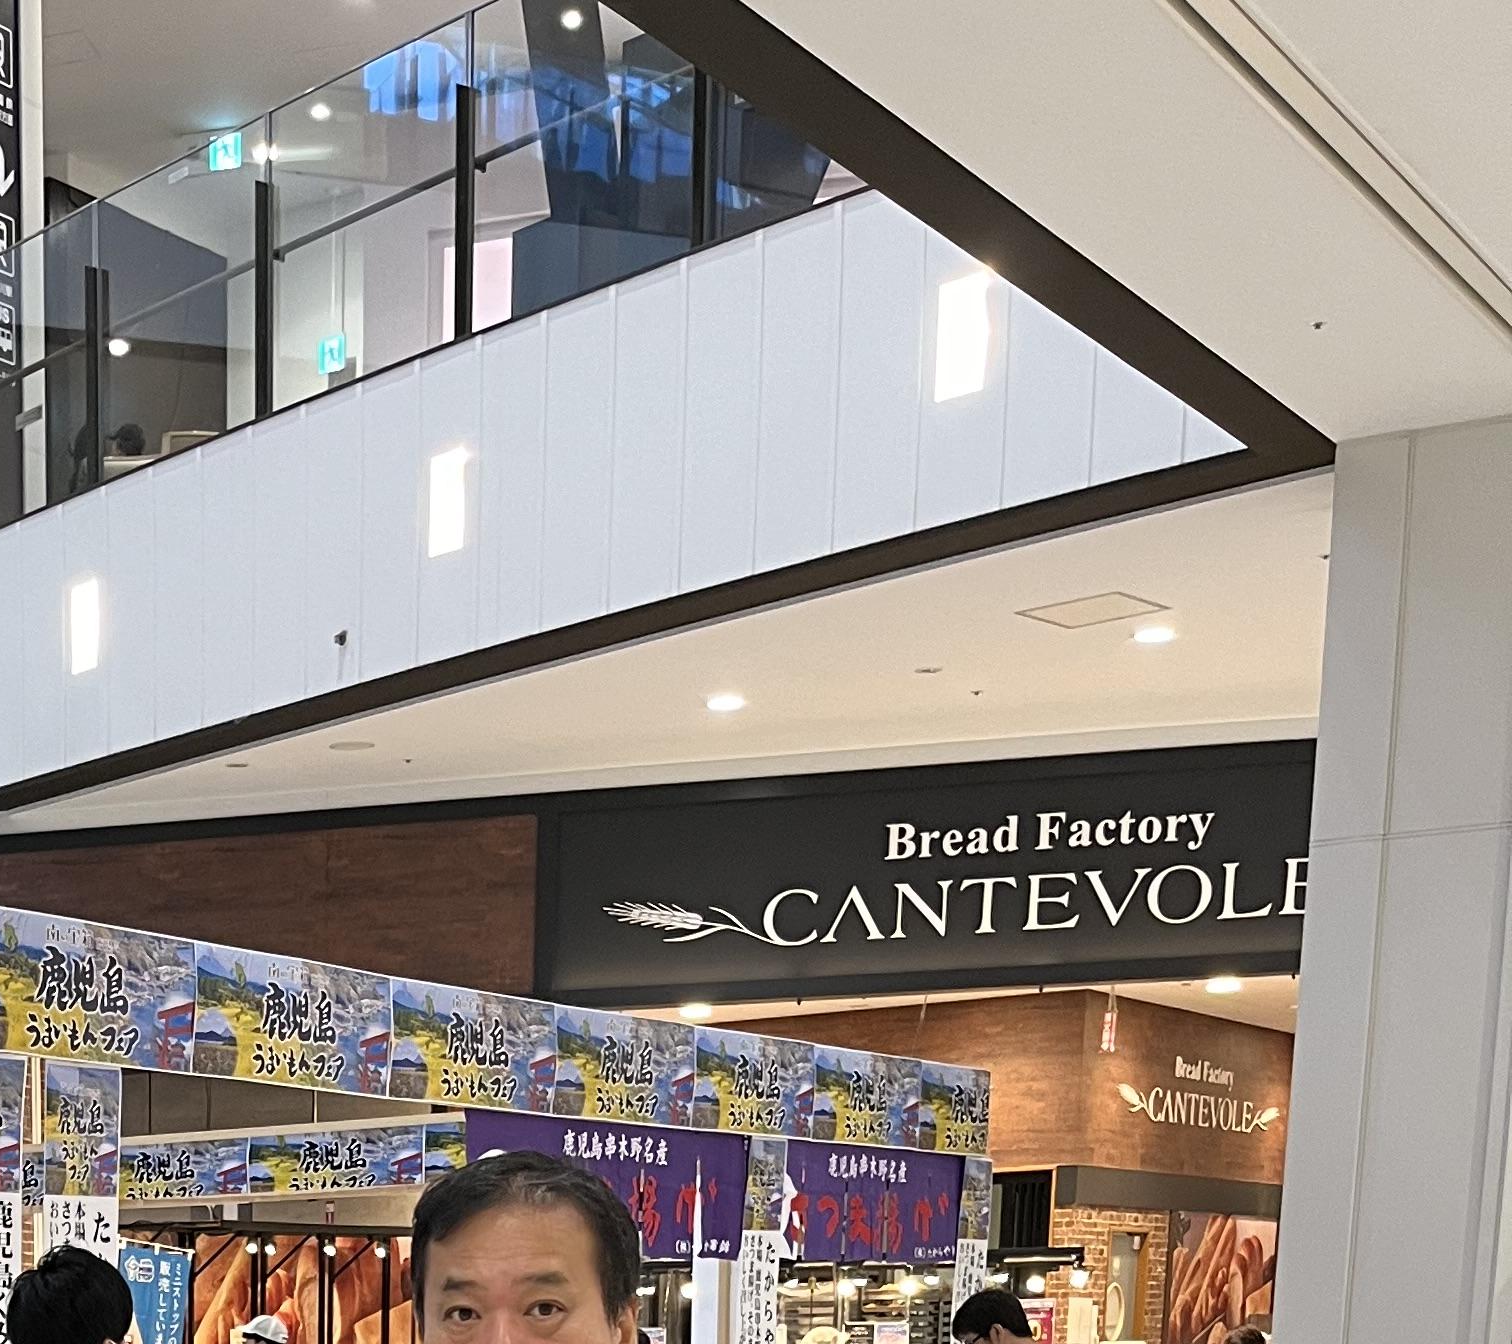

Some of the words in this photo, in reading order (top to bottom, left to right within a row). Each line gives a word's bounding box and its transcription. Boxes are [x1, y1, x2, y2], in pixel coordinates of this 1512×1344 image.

[883, 815, 1020, 862] Bread
[1033, 809, 1216, 851] Factory
[35, 946, 130, 1016] 鹿児島
[24, 1013, 140, 1058] うまいもんフェア
[260, 981, 337, 1045] 鹿児島
[252, 1043, 345, 1082] うまいもんフェア
[446, 1011, 510, 1069] 鹿児島
[599, 1035, 654, 1087] 鹿児島
[1175, 1054, 1202, 1082] Bread
[1202, 1060, 1235, 1092] Factory
[57, 1096, 105, 1136] 鹿児島
[1147, 1086, 1255, 1134] CANTEVOLE
[134, 1149, 196, 1183] 鹿児島
[298, 1138, 367, 1174] 鹿児島
